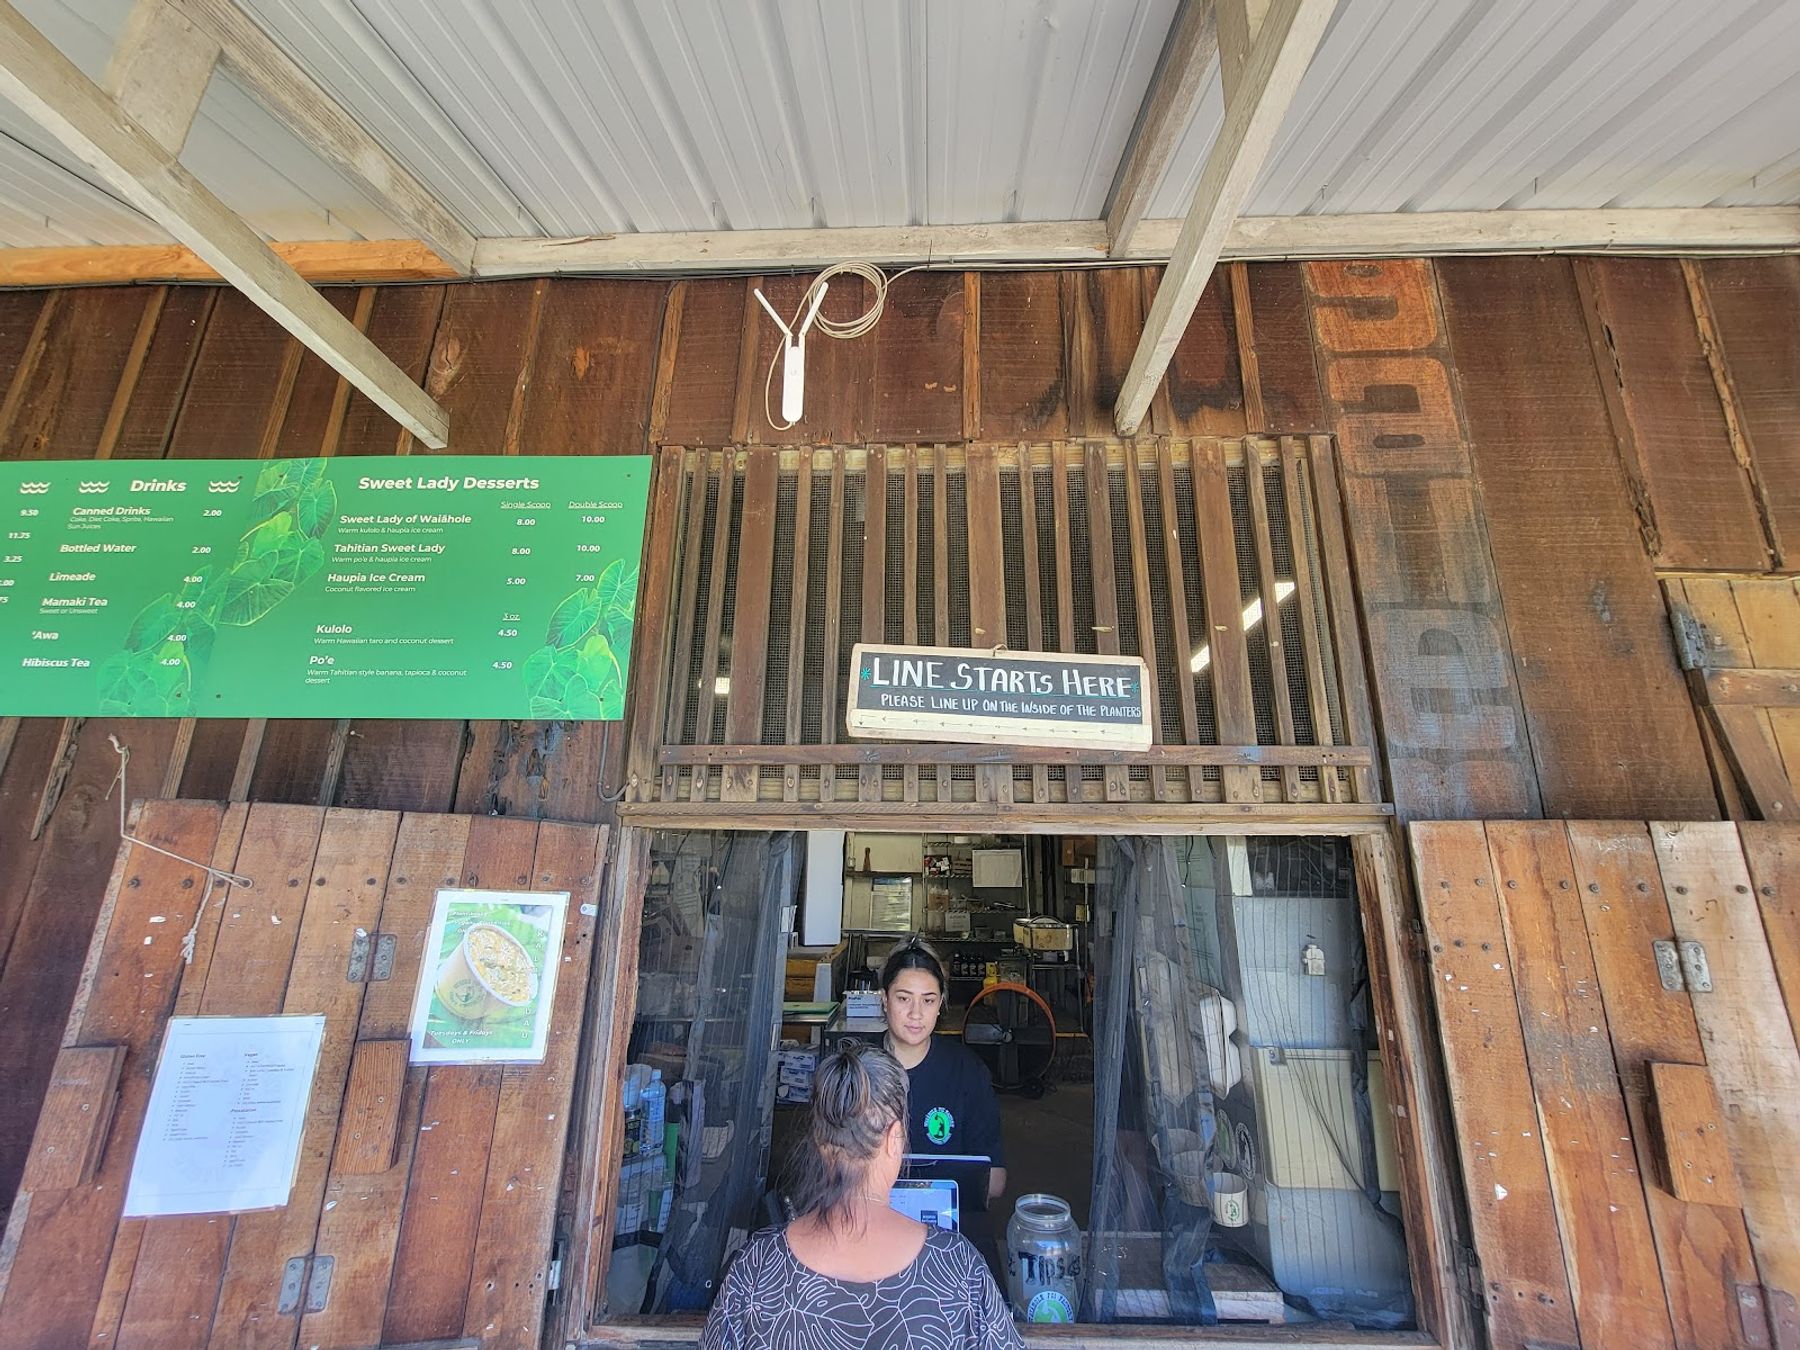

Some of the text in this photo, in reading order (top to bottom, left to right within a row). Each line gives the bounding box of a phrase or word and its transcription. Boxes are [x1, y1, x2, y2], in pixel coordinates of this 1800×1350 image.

[130, 478, 188, 493] Drinks
[358, 476, 540, 492] Sweet Lady Desserts
[500, 500, 552, 510] Single Scoop
[568, 500, 624, 510] Double Scoop
[72, 506, 152, 516] Canned Drinks
[202, 509, 223, 517] 2.00
[339, 514, 375, 524] Sweet
[376, 514, 404, 526] Lady
[405, 514, 418, 524] of
[516, 518, 537, 526] 8.00
[581, 515, 606, 523] 10.00
[337, 527, 359, 535] Warm
[386, 526, 411, 535] haupia
[59, 543, 137, 554] Bottled Water
[191, 546, 212, 554] 2.00
[334, 543, 446, 555] Tahitian Sweet Lady
[511, 547, 532, 555] 8.00
[576, 544, 602, 552] 10.00
[3, 555, 23, 563] 3.25
[331, 556, 353, 564] Warm
[374, 556, 399, 564] haupia
[49, 572, 97, 582] Limeade
[326, 572, 426, 584] Haupia Ice Cream
[506, 577, 527, 585] 5.00
[575, 574, 596, 582] 7.00
[41, 597, 108, 607] Mamaki Tea
[39, 607, 61, 615] Sweet
[69, 607, 99, 615] Unsweet
[315, 624, 353, 635] Kulolo
[497, 628, 518, 636] 4.50
[167, 634, 188, 642] 4.00
[313, 637, 455, 645] Warm Hawaiian taro and coconut dessert
[21, 657, 91, 669] Hibiscus Tea
[160, 659, 182, 667] 4.00
[309, 655, 335, 666] Po'e
[491, 661, 513, 669] 4.50
[307, 669, 329, 677] Warm
[329, 669, 358, 677] Tahitian
[358, 669, 375, 678] style
[404, 669, 431, 678] tapioca
[437, 669, 468, 677] coconut
[873, 657, 1131, 698] LINE STARTS HERE
[304, 677, 331, 685] dessert
[880, 692, 1142, 719] PLEASE LINE UP ON THE INSIDE OF THE PLANTERS
[431, 1029, 462, 1037] Tuesdays
[469, 1029, 494, 1037] Fridays
